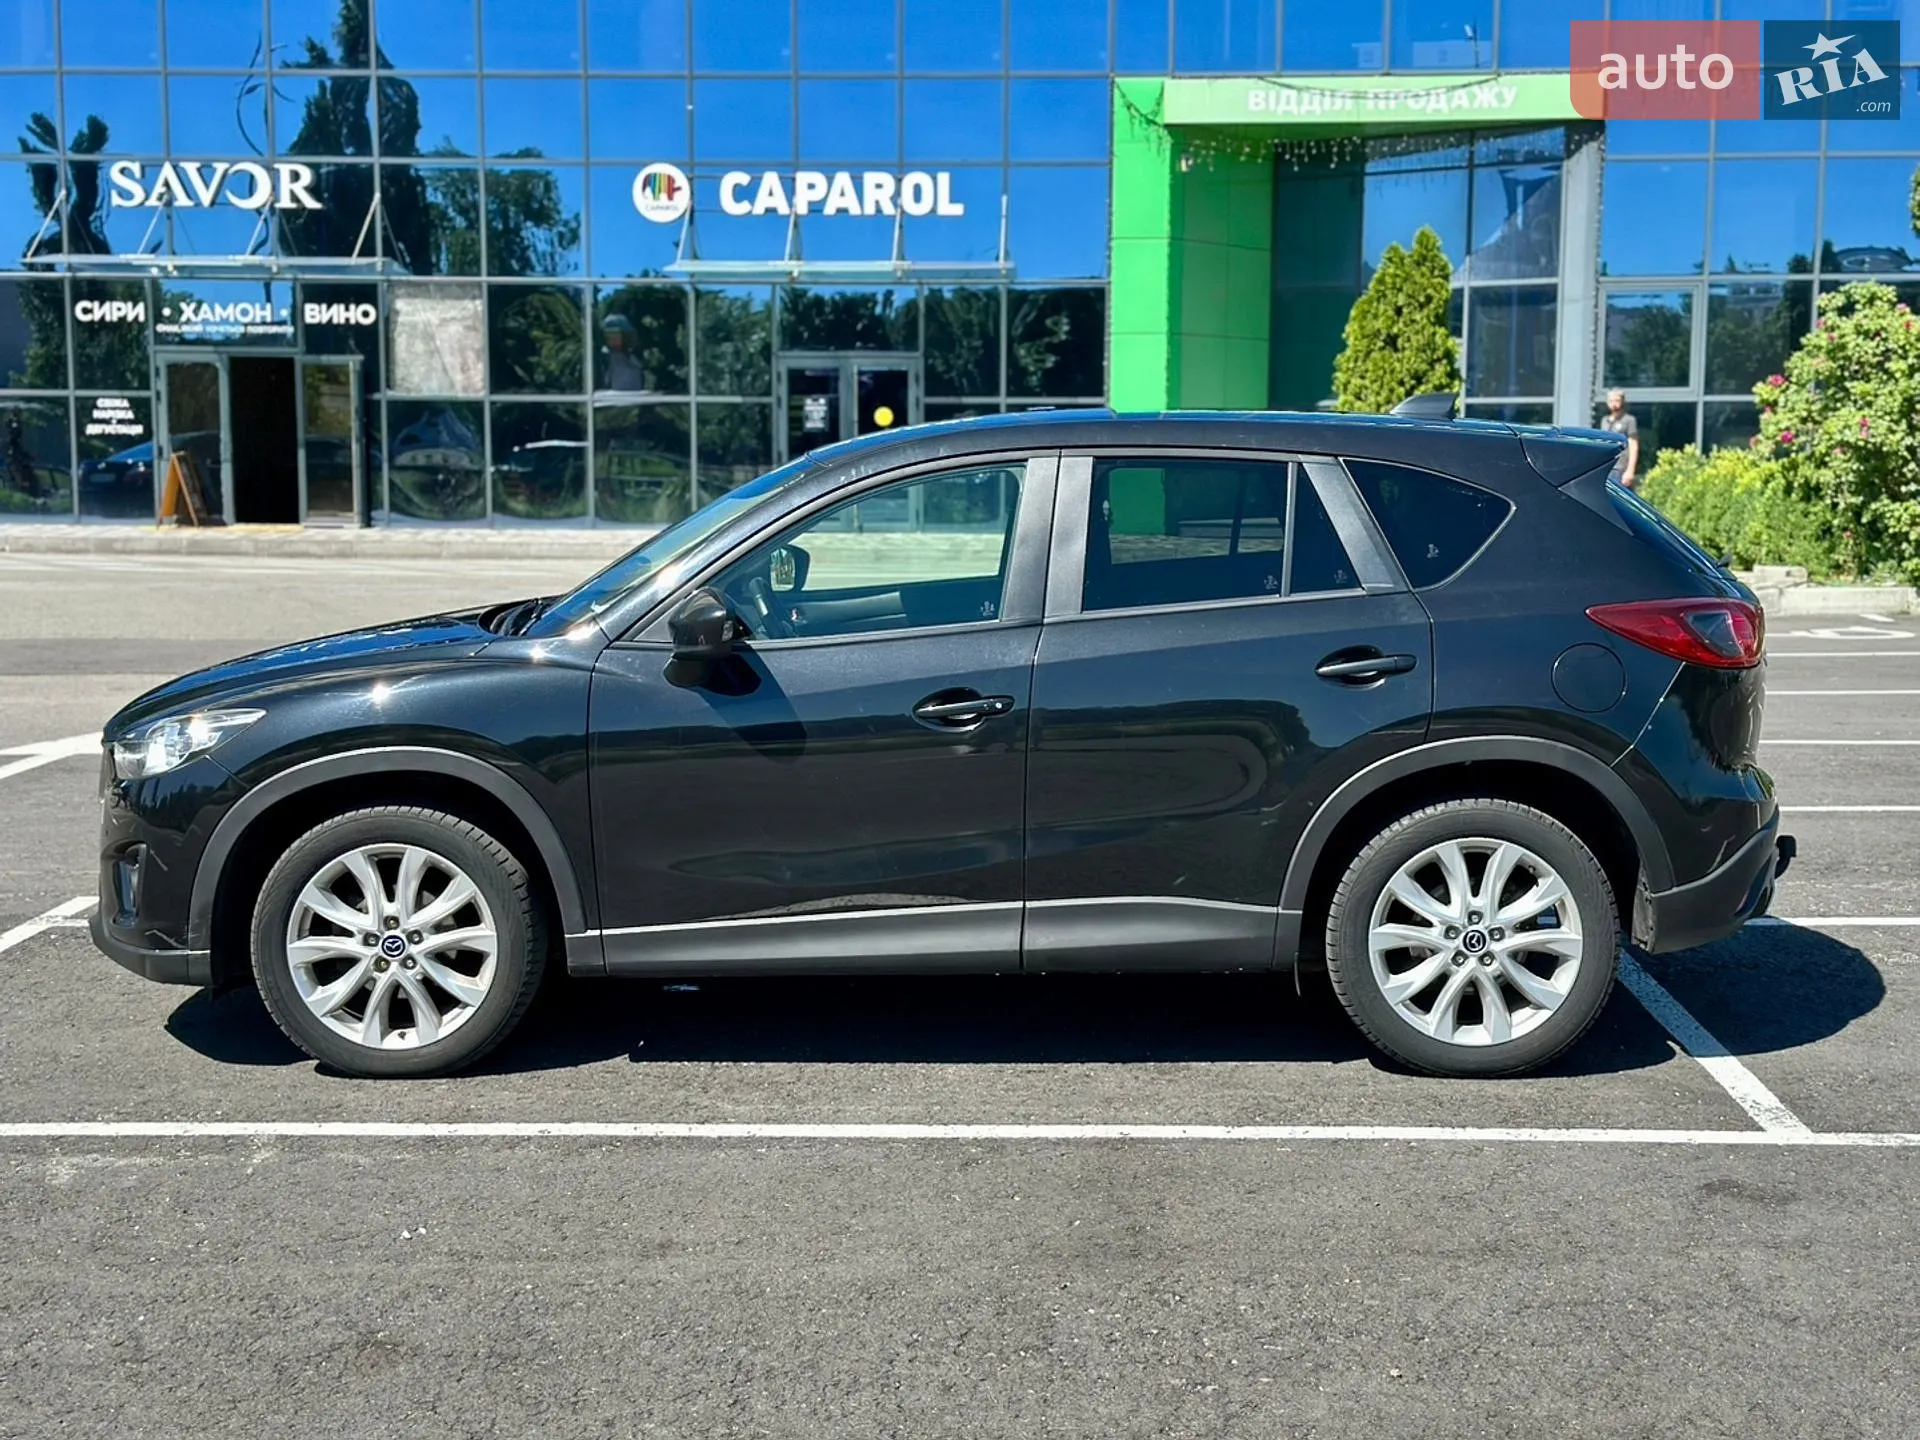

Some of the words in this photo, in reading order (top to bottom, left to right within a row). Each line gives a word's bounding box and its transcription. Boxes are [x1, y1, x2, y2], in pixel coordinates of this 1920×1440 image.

[1248, 89, 1353, 116] ВІДДІЛ
[1366, 85, 1517, 114] ПРОДАЖУ
[110, 160, 322, 210] SAVOR
[719, 171, 964, 216] CAPAROL
[75, 300, 145, 322] СИРИ
[179, 302, 271, 322] ХАМОН
[304, 302, 377, 325] ВИНО
